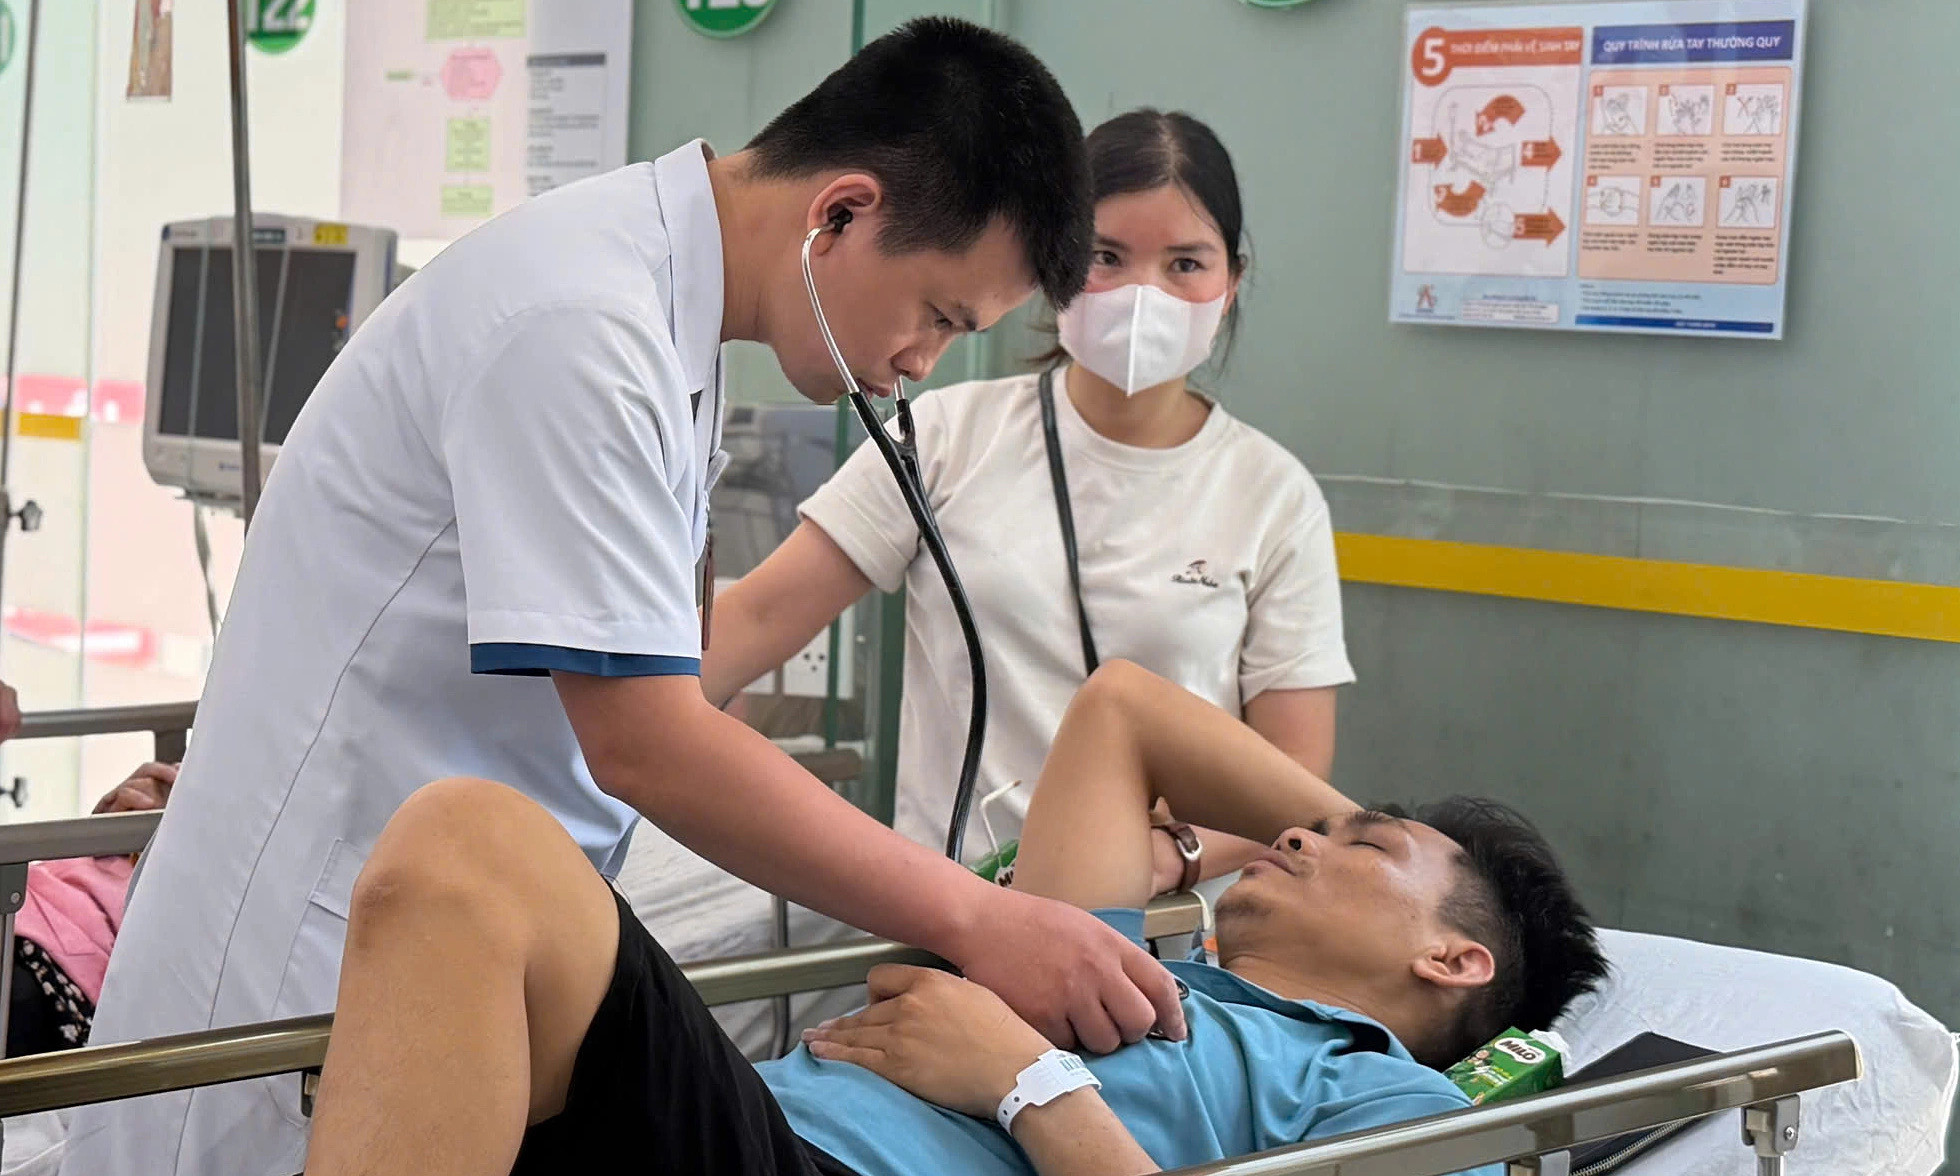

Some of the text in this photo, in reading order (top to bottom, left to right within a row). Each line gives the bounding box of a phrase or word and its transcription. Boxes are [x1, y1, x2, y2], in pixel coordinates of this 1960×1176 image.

[1602, 40, 1626, 53] QUY
[1627, 36, 1660, 51] TRÌNH
[1686, 37, 1706, 50] TAY
[1756, 35, 1783, 49] QUY
[1421, 37, 1446, 77] 5
[1499, 1040, 1537, 1061] MILO
